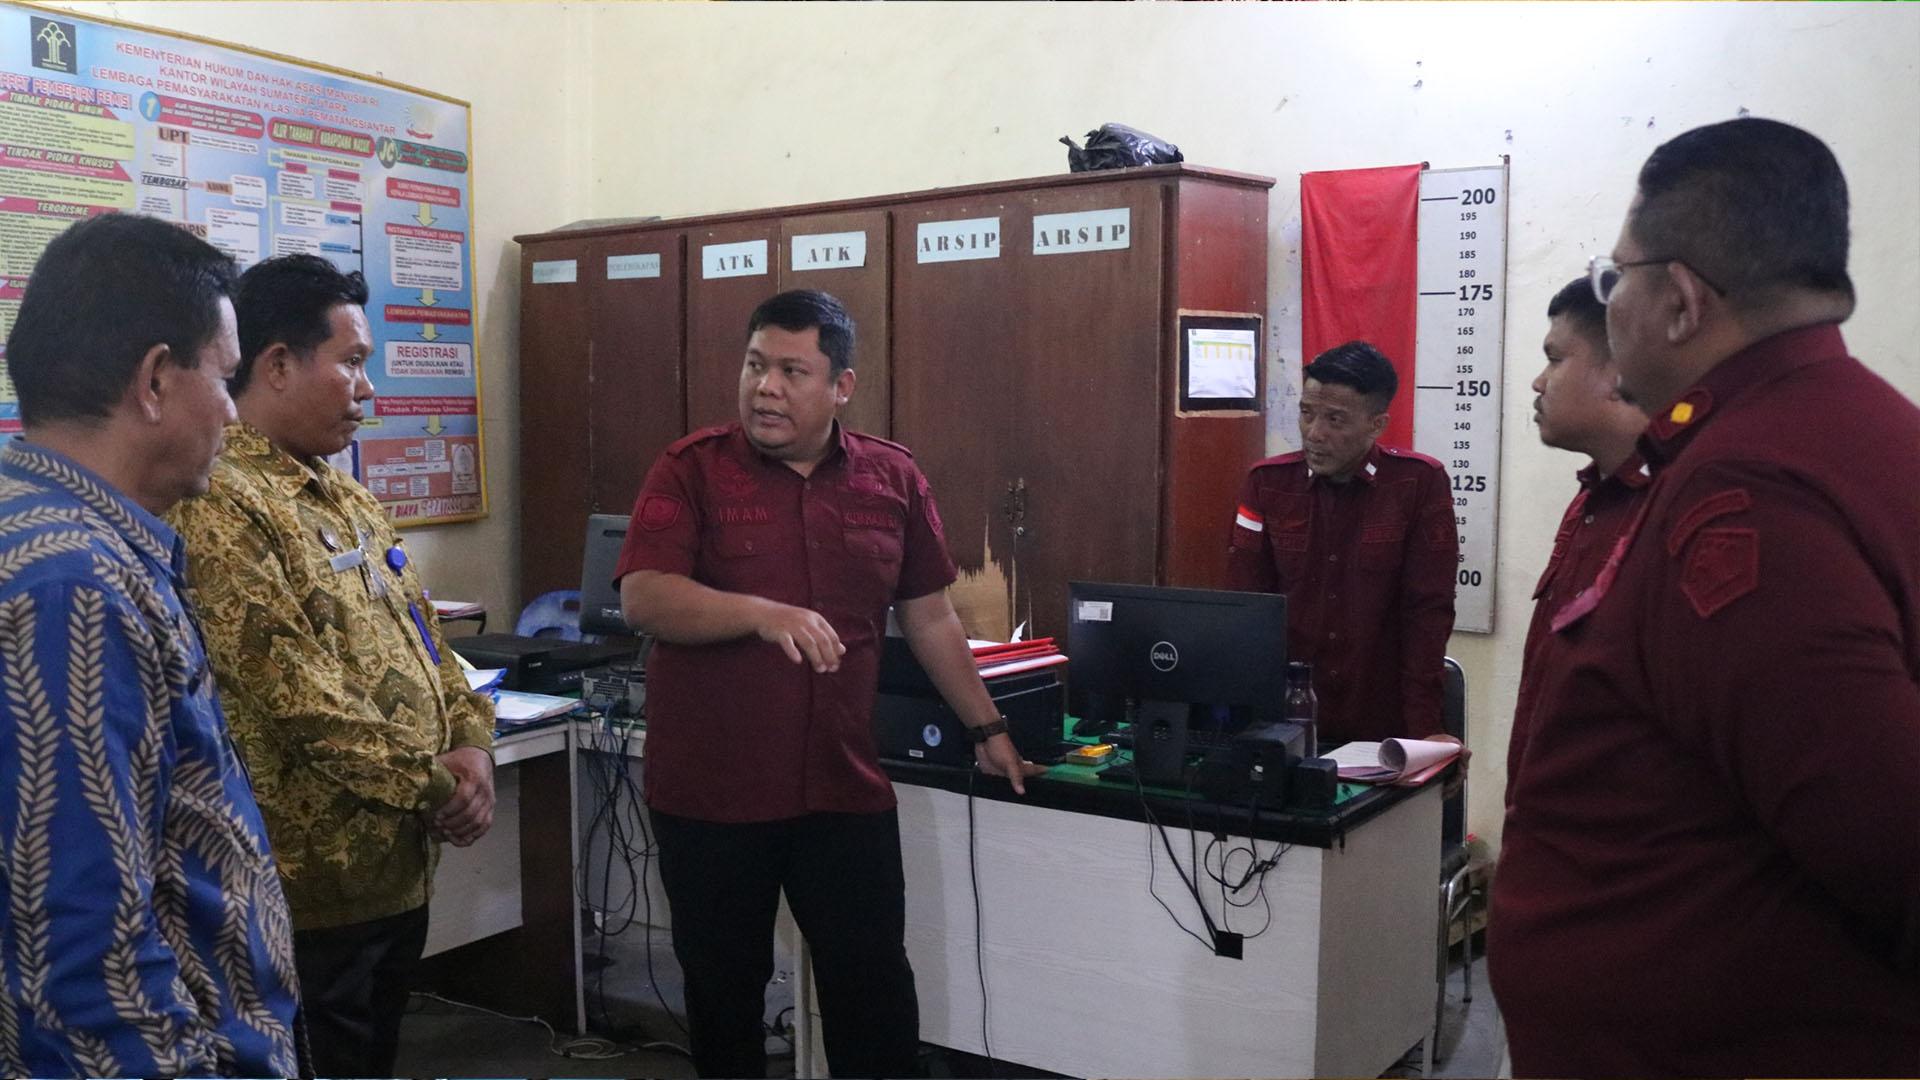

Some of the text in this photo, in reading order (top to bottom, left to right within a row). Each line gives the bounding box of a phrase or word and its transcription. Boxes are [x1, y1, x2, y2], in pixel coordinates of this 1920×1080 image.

[116, 42, 201, 68] KEMENTERIAN
[205, 62, 243, 78] HUKUM
[247, 70, 271, 83] DAN
[271, 77, 293, 89] HAK
[92, 67, 153, 88] LEMBAGA
[157, 79, 261, 109] PEMASYARAKATAN
[263, 101, 290, 114] KLAS
[159, 66, 207, 85] KANTOR
[210, 76, 257, 94] WILAYAH
[260, 87, 314, 105] SUMATERA
[159, 127, 189, 143] UPT
[6, 147, 42, 160] TINDAK
[78, 157, 115, 169] KHUSUS
[1461, 188, 1496, 205] 200
[38, 202, 89, 215] TERORISME
[1460, 212, 1477, 221] 195
[920, 232, 997, 252] ARSIP
[1036, 224, 1125, 247] ARSIP
[1460, 231, 1477, 240] 190
[808, 246, 851, 263] ATK
[1459, 250, 1476, 259] 185
[717, 254, 754, 271] ATK
[1458, 269, 1476, 278] 180
[1459, 284, 1493, 301] 175
[1458, 307, 1475, 316] 170
[1457, 327, 1474, 335] 165
[397, 346, 458, 359] REGISTRASI
[1457, 346, 1474, 354] 160
[1456, 365, 1473, 374] 155
[1456, 380, 1491, 396] 150
[1455, 403, 1472, 411] 145
[1454, 422, 1471, 430] 140
[1453, 441, 1470, 450] 135
[1452, 460, 1469, 468] 130
[1452, 475, 1486, 492] 125
[718, 507, 768, 521] IMAM
[1459, 569, 1482, 586] 00
[1153, 652, 1175, 661] DELL
